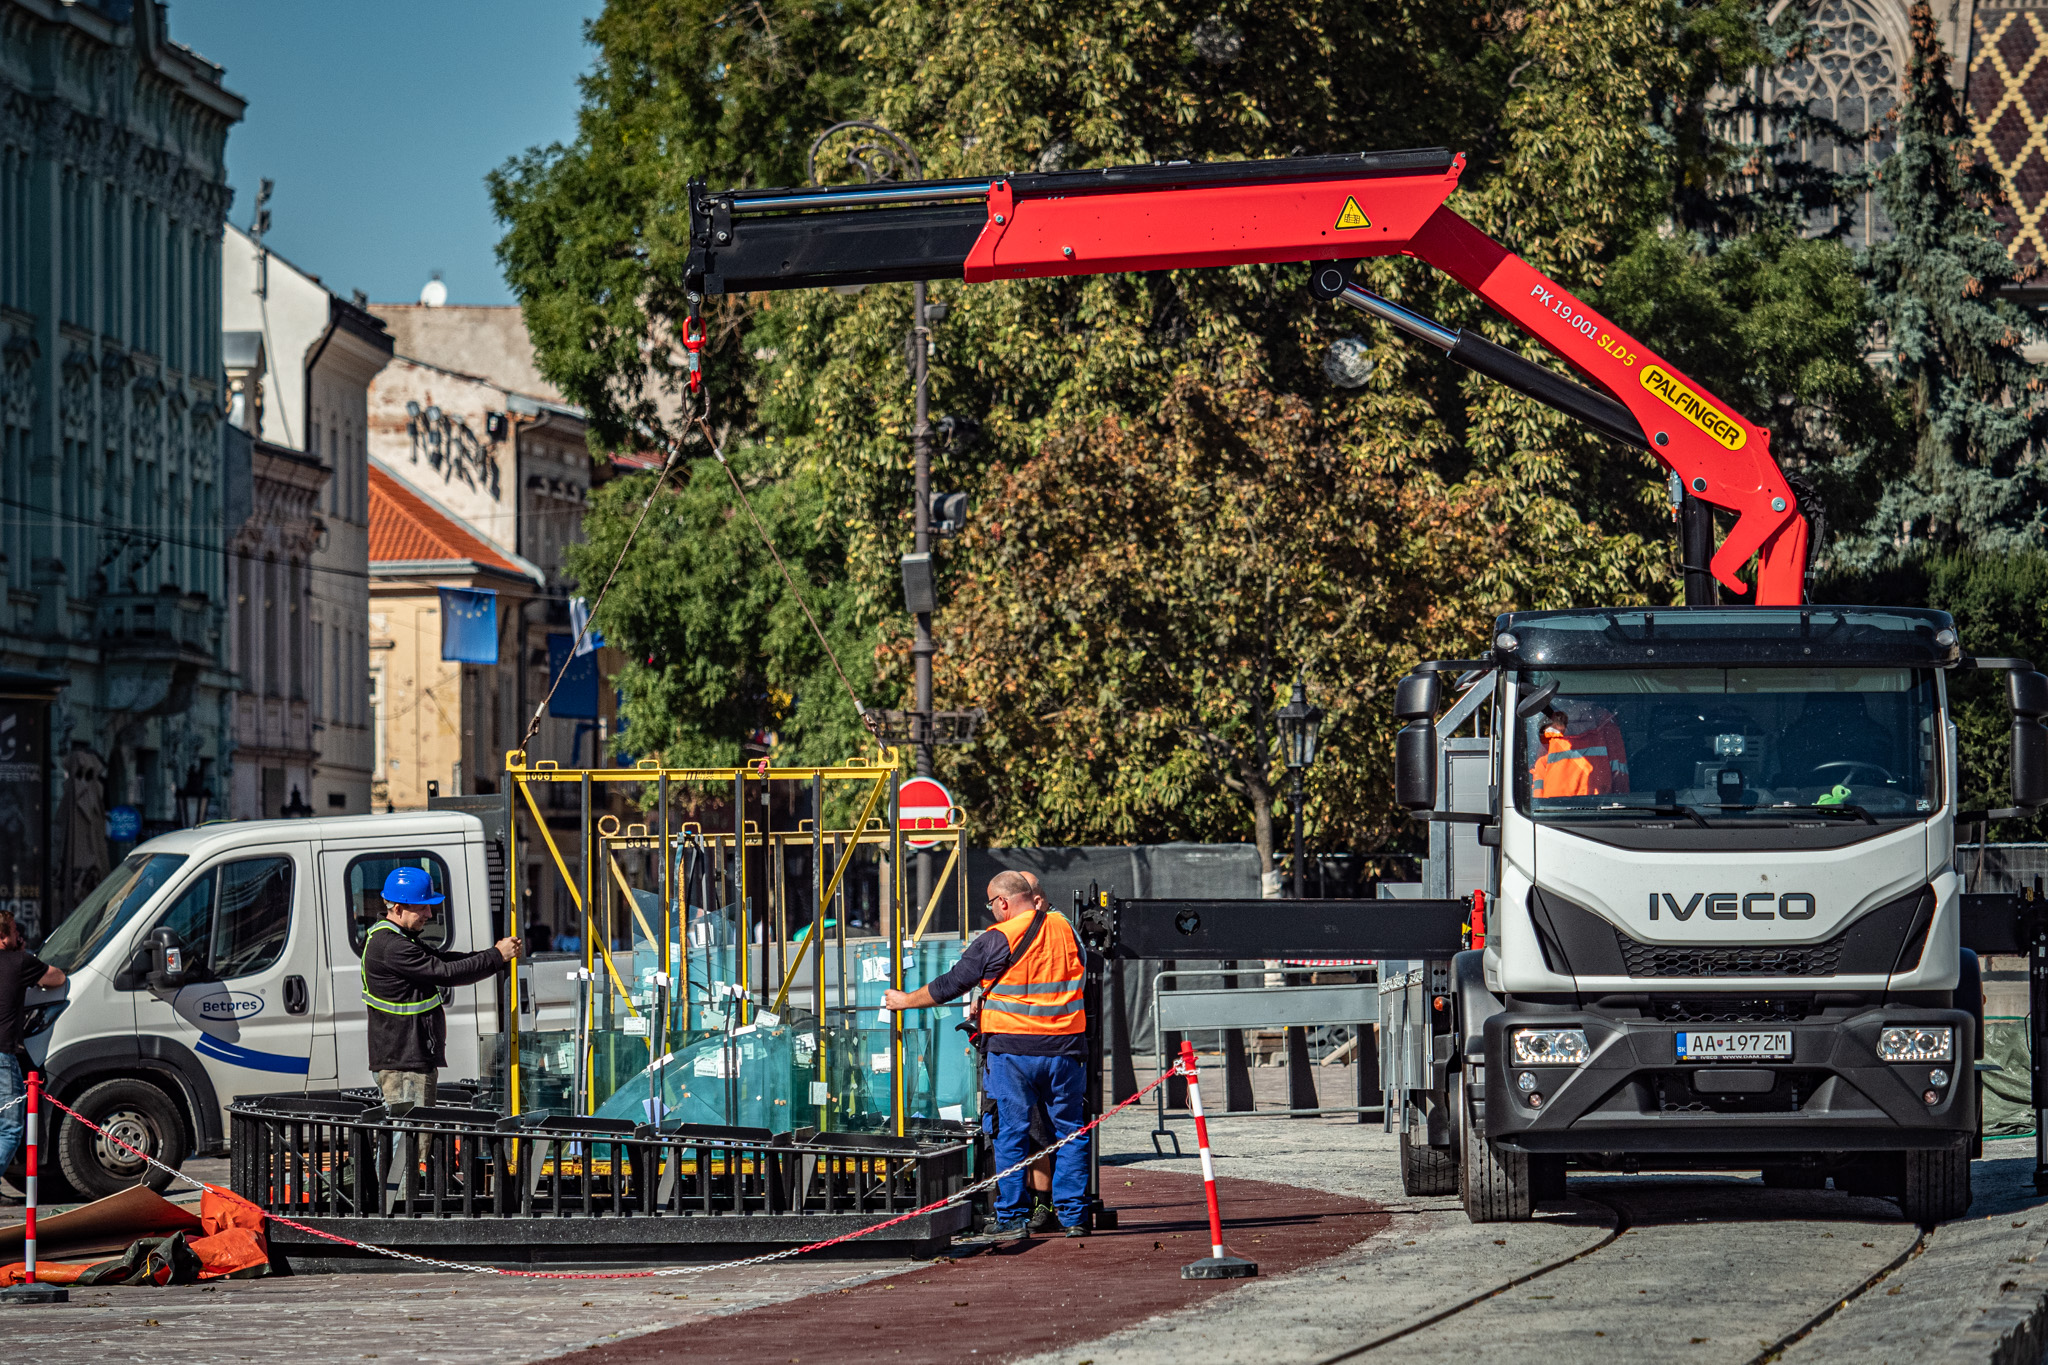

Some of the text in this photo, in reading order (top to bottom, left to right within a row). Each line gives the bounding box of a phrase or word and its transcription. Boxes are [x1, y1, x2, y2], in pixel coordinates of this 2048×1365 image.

[1530, 284, 1554, 307] PK
[1551, 300, 1598, 340] 19.001
[1645, 369, 1740, 446] PALFINGER
[526, 772, 551, 781] 1006
[627, 838, 649, 848] 364
[1649, 892, 1816, 922] IVECO
[202, 1000, 257, 1013] Betpres
[1692, 1034, 1786, 1052] AA 197ZM
